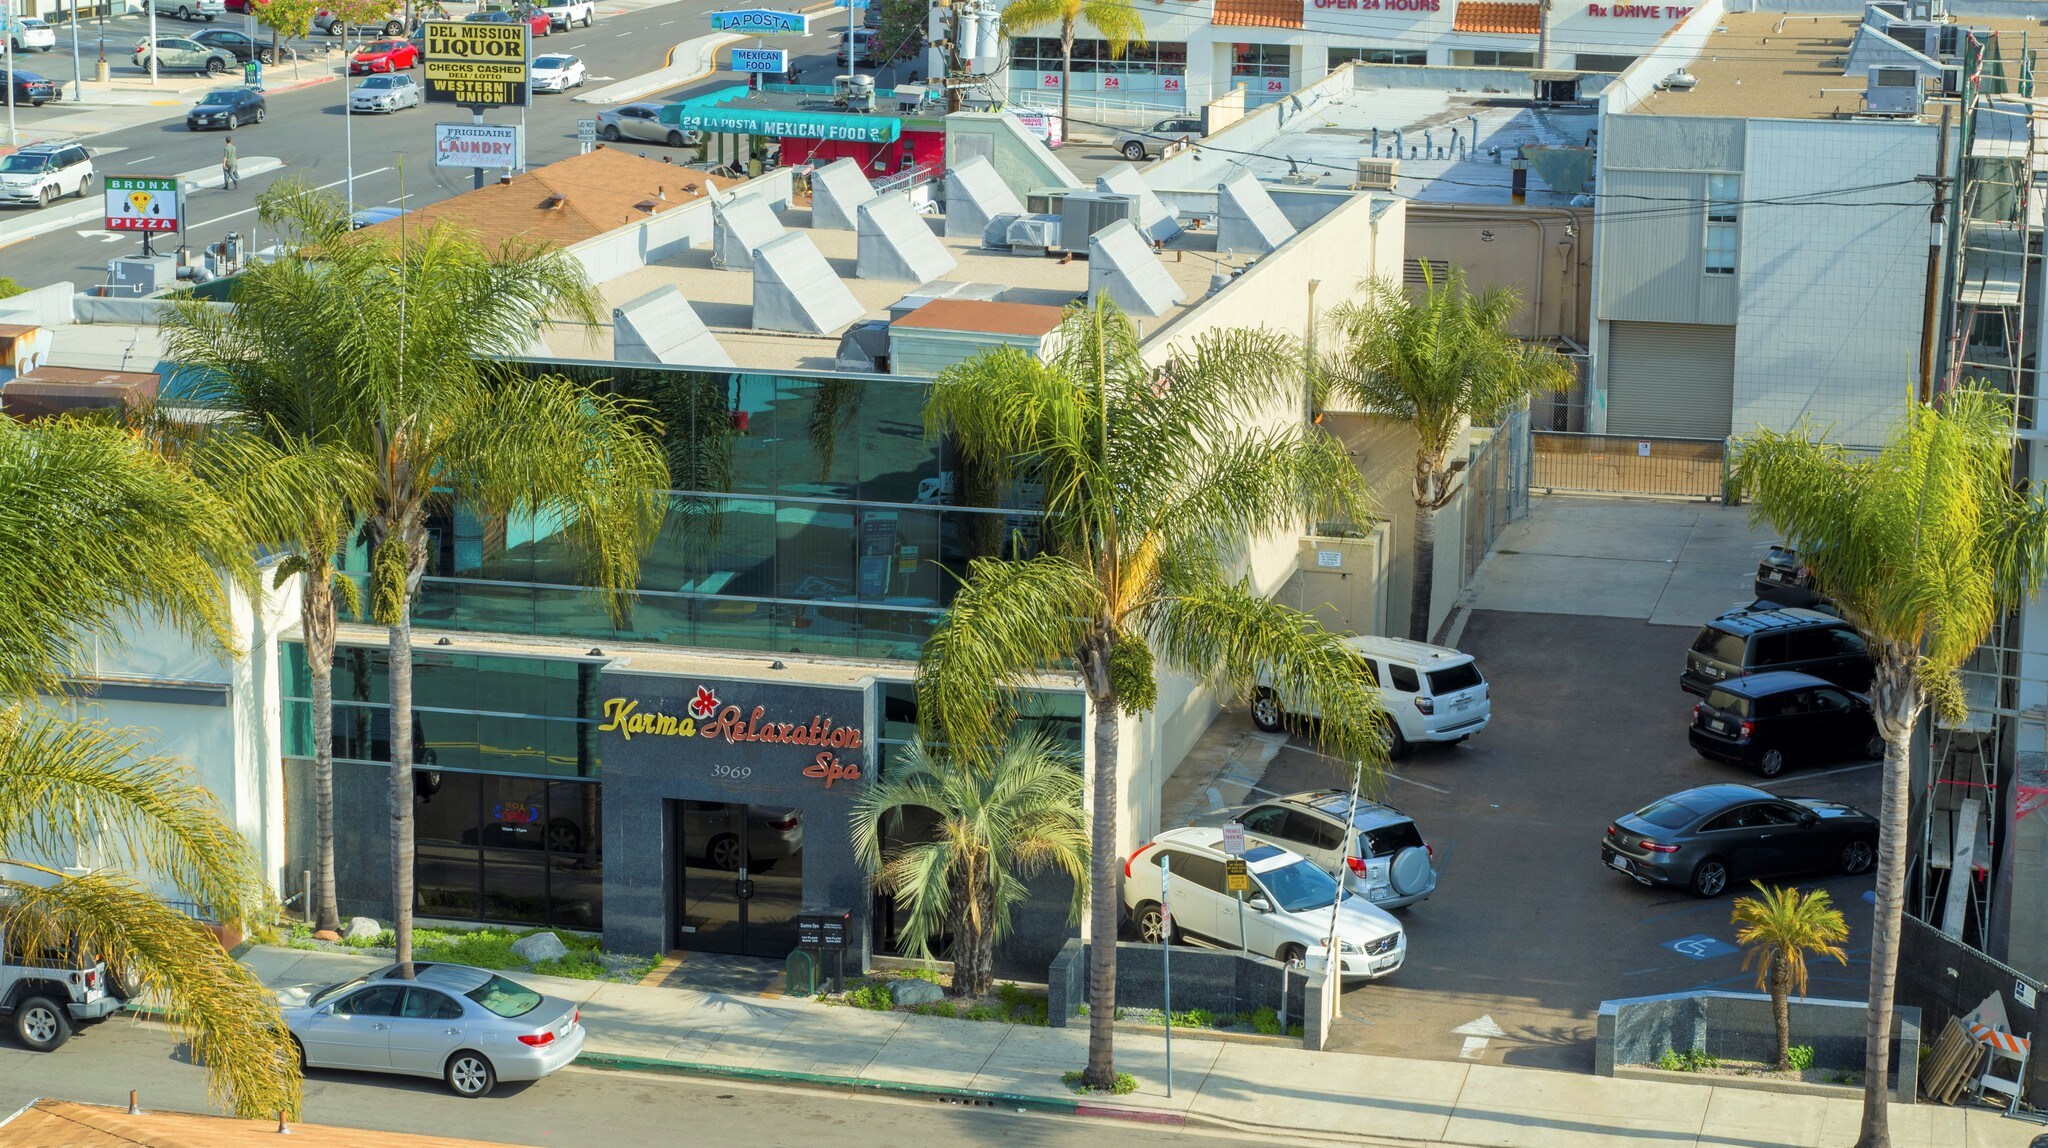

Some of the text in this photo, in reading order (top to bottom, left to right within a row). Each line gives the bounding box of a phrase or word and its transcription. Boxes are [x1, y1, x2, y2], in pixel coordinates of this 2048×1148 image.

[1314, 0, 1440, 12] OPEN 24 HOURS
[1588, 4, 1607, 17] Rx
[1613, 4, 1660, 19] DRIVE
[723, 14, 791, 32] LA POSTA
[430, 26, 521, 40] DEL MISSION
[429, 39, 521, 57] LIQUOR
[738, 52, 779, 60] MEXICAN
[429, 63, 521, 74] CHECKS CASHED
[746, 61, 772, 70] FOOD
[1044, 75, 1059, 84] 24
[1104, 77, 1119, 86] 24
[1164, 79, 1179, 88] 24
[1267, 81, 1282, 90] 24
[433, 80, 504, 93] WESTERN
[456, 91, 504, 103] UNION
[448, 129, 512, 138] FRIGIDAIRE
[683, 116, 701, 126] 24
[704, 117, 718, 127] LA
[721, 118, 757, 129] POSTA
[764, 121, 825, 137] MEXICAN
[829, 126, 867, 140] FOOD
[438, 141, 512, 155] LAUNDRY
[450, 154, 468, 164] Dry
[471, 155, 513, 167] Cleaning
[112, 180, 170, 190] BRONX
[111, 218, 171, 228] PIZZA
[598, 698, 863, 749] Karma Relaxation
[710, 764, 752, 780] 3969
[803, 751, 862, 789] Spa
[505, 802, 526, 812] SPA
[502, 811, 529, 823] OPEN
